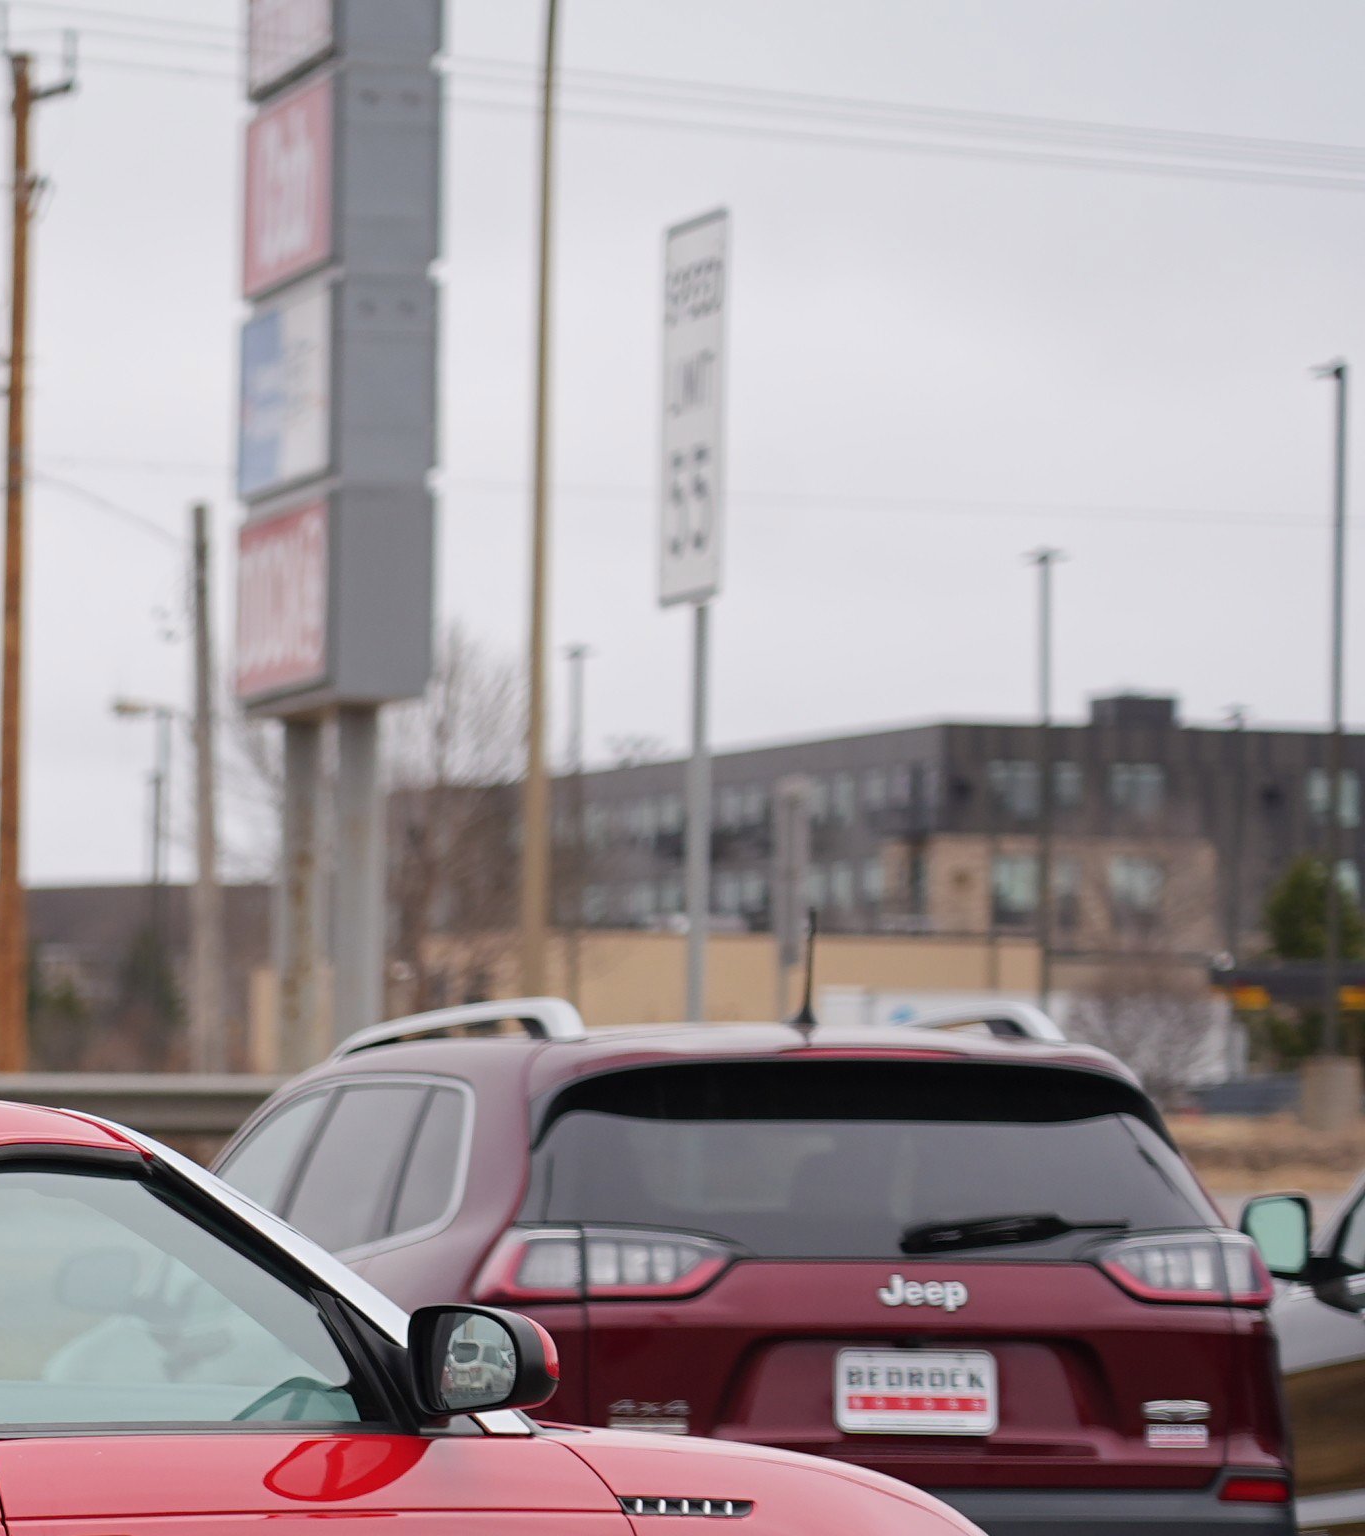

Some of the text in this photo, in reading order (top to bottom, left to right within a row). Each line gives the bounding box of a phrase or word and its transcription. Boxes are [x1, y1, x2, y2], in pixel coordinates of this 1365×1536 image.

[670, 446, 712, 557] 55
[877, 1273, 968, 1312] Jeep
[845, 1366, 985, 1389] BEDROCK
